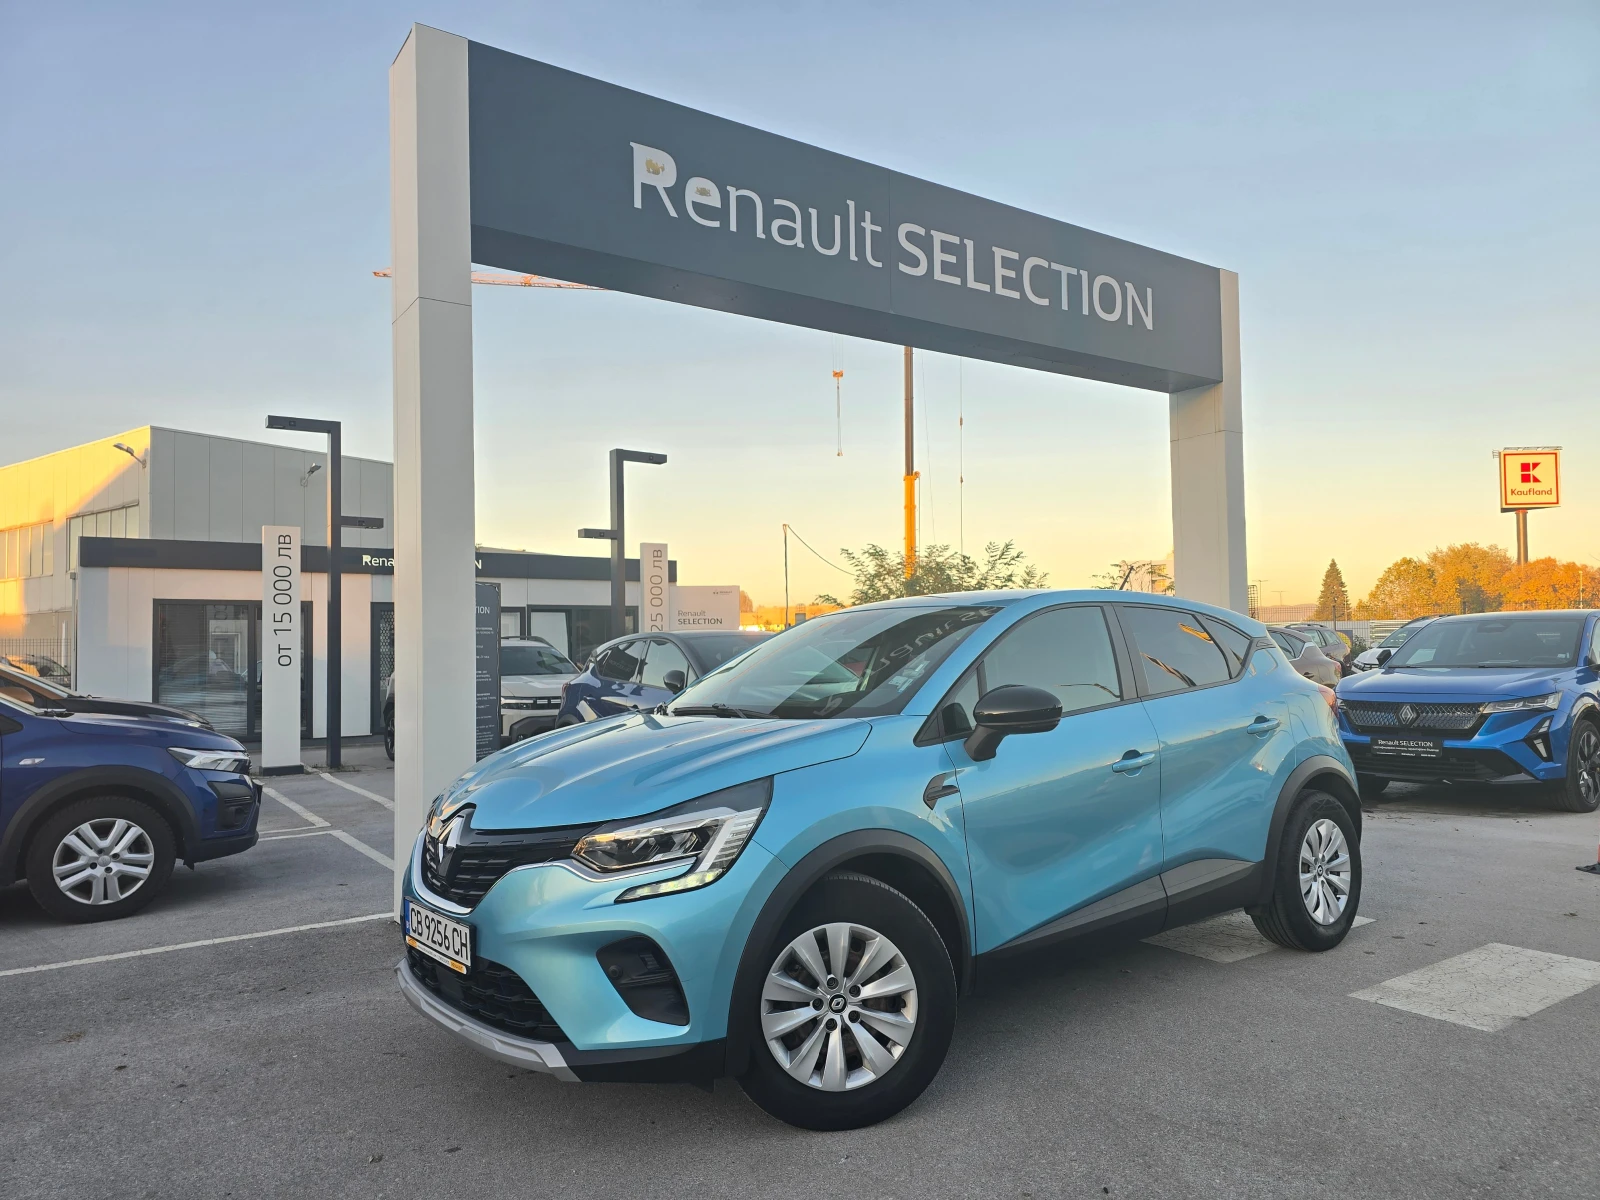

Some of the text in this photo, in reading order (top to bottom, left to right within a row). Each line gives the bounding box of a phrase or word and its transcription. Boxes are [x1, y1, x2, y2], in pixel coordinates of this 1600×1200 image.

[629, 141, 1155, 331] Renault SELECTION
[1510, 488, 1553, 496] Kaufland
[362, 554, 394, 567] Rena
[273, 565, 292, 605] 000
[649, 574, 664, 608] 000
[273, 612, 292, 636] 15
[650, 612, 664, 632] 25
[410, 907, 423, 937] CB
[424, 914, 450, 951] 9256
[451, 927, 468, 961] CH
